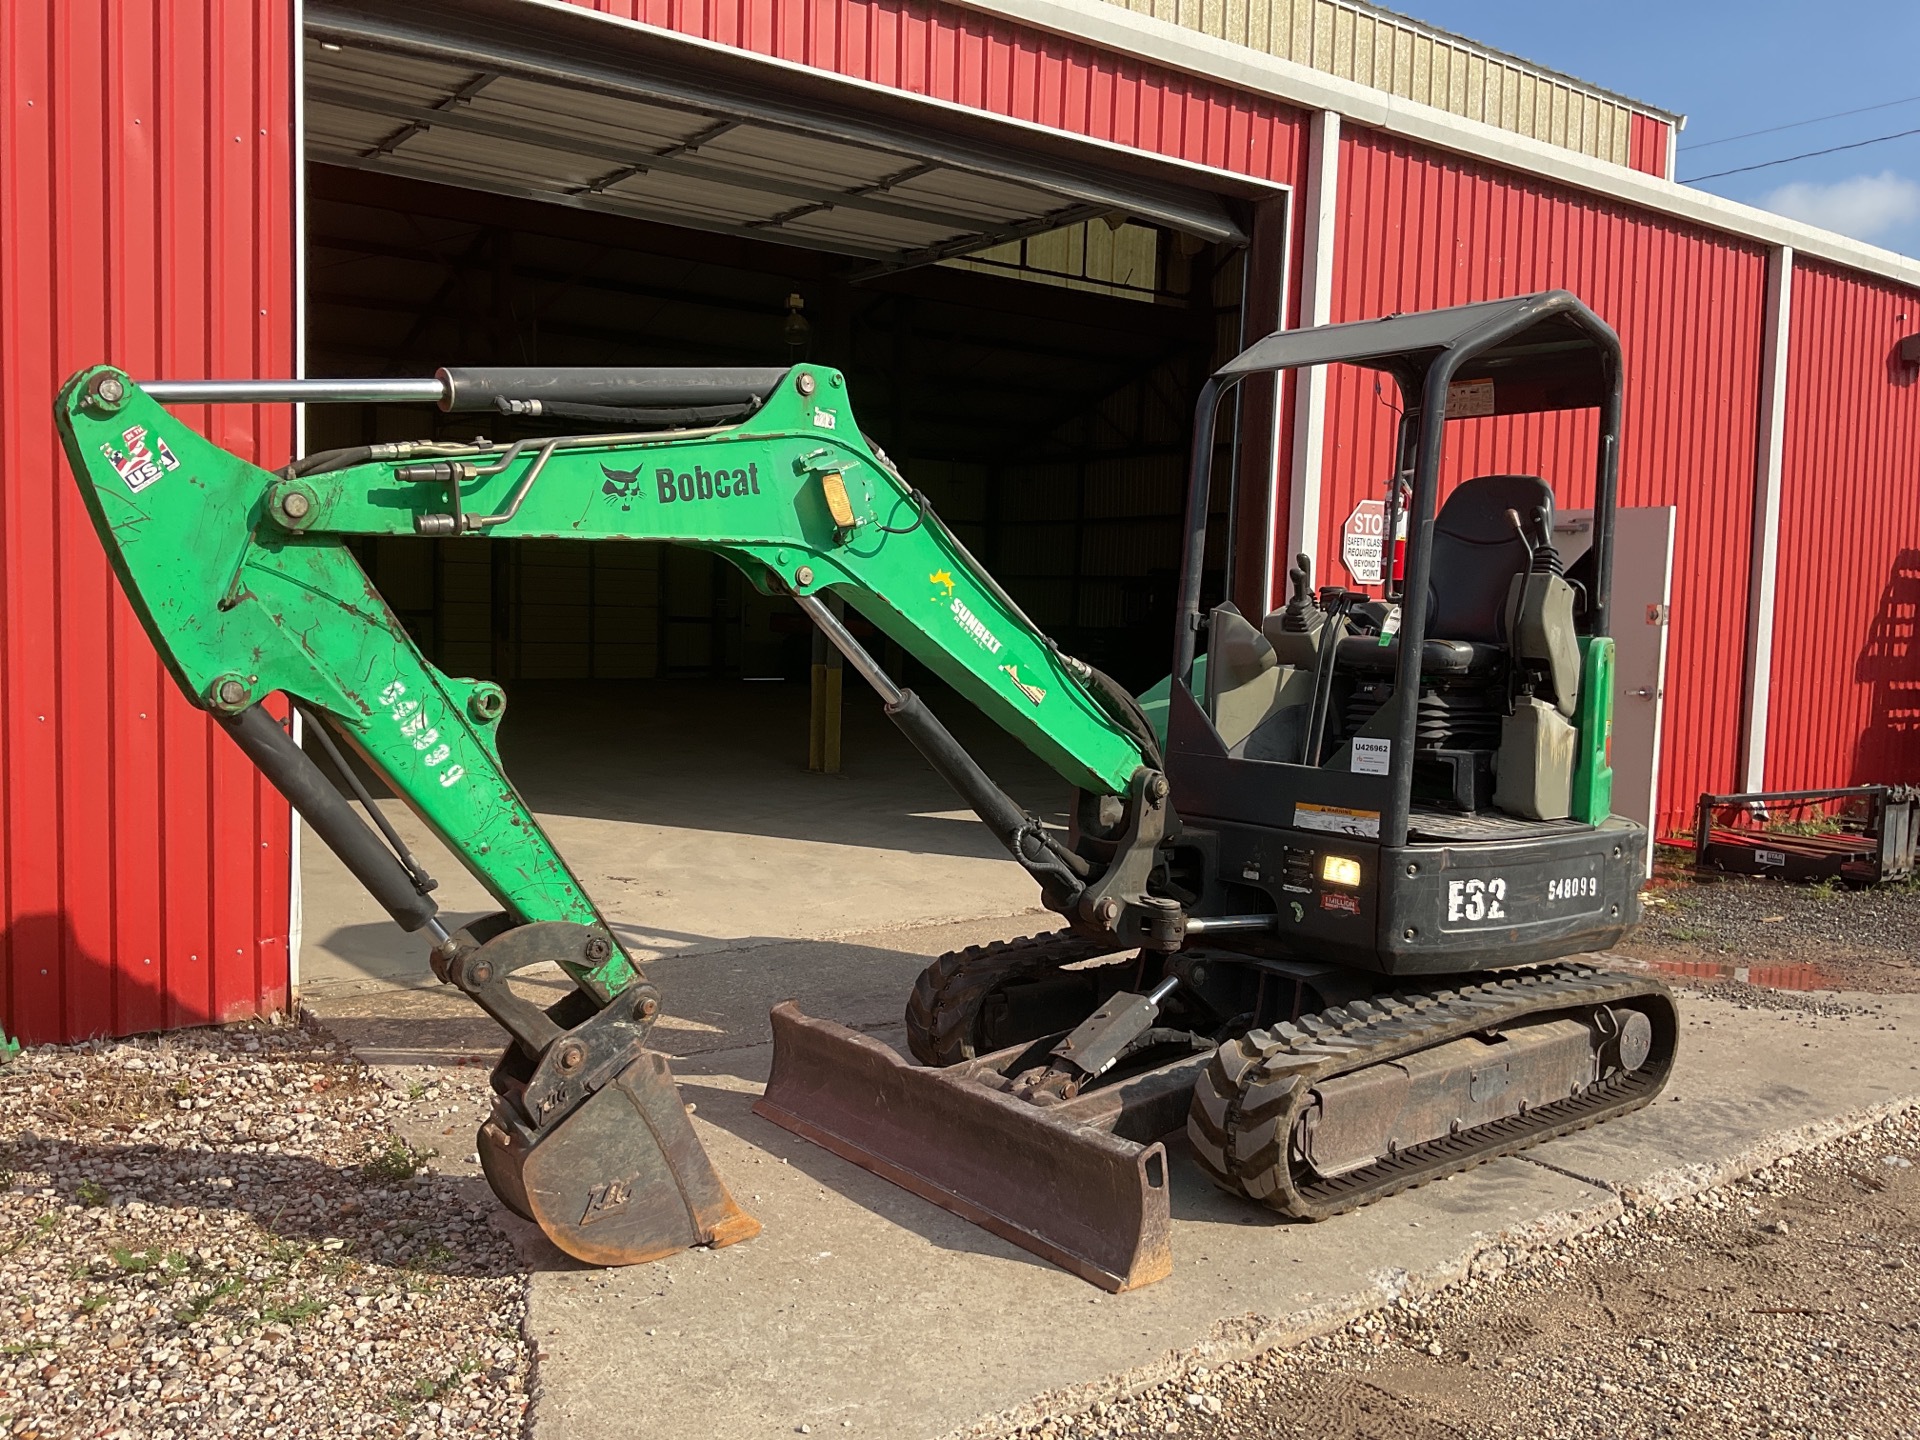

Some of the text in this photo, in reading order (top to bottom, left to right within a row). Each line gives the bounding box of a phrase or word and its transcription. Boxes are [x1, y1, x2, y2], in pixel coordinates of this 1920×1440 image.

[655, 462, 761, 504] Bobcat
[1354, 513, 1383, 534] STO
[1348, 537, 1366, 547] SAFETY
[1348, 548, 1377, 558] REQUIRED
[1353, 559, 1375, 568] BEYOND
[1362, 569, 1378, 577] POINT
[950, 597, 1003, 654] SUNBELT
[953, 616, 985, 651] RENTAL
[1355, 743, 1388, 753] U426962
[1327, 807, 1352, 815] WARNING
[1328, 897, 1355, 908] MILLION
[1448, 877, 1507, 922] E32
